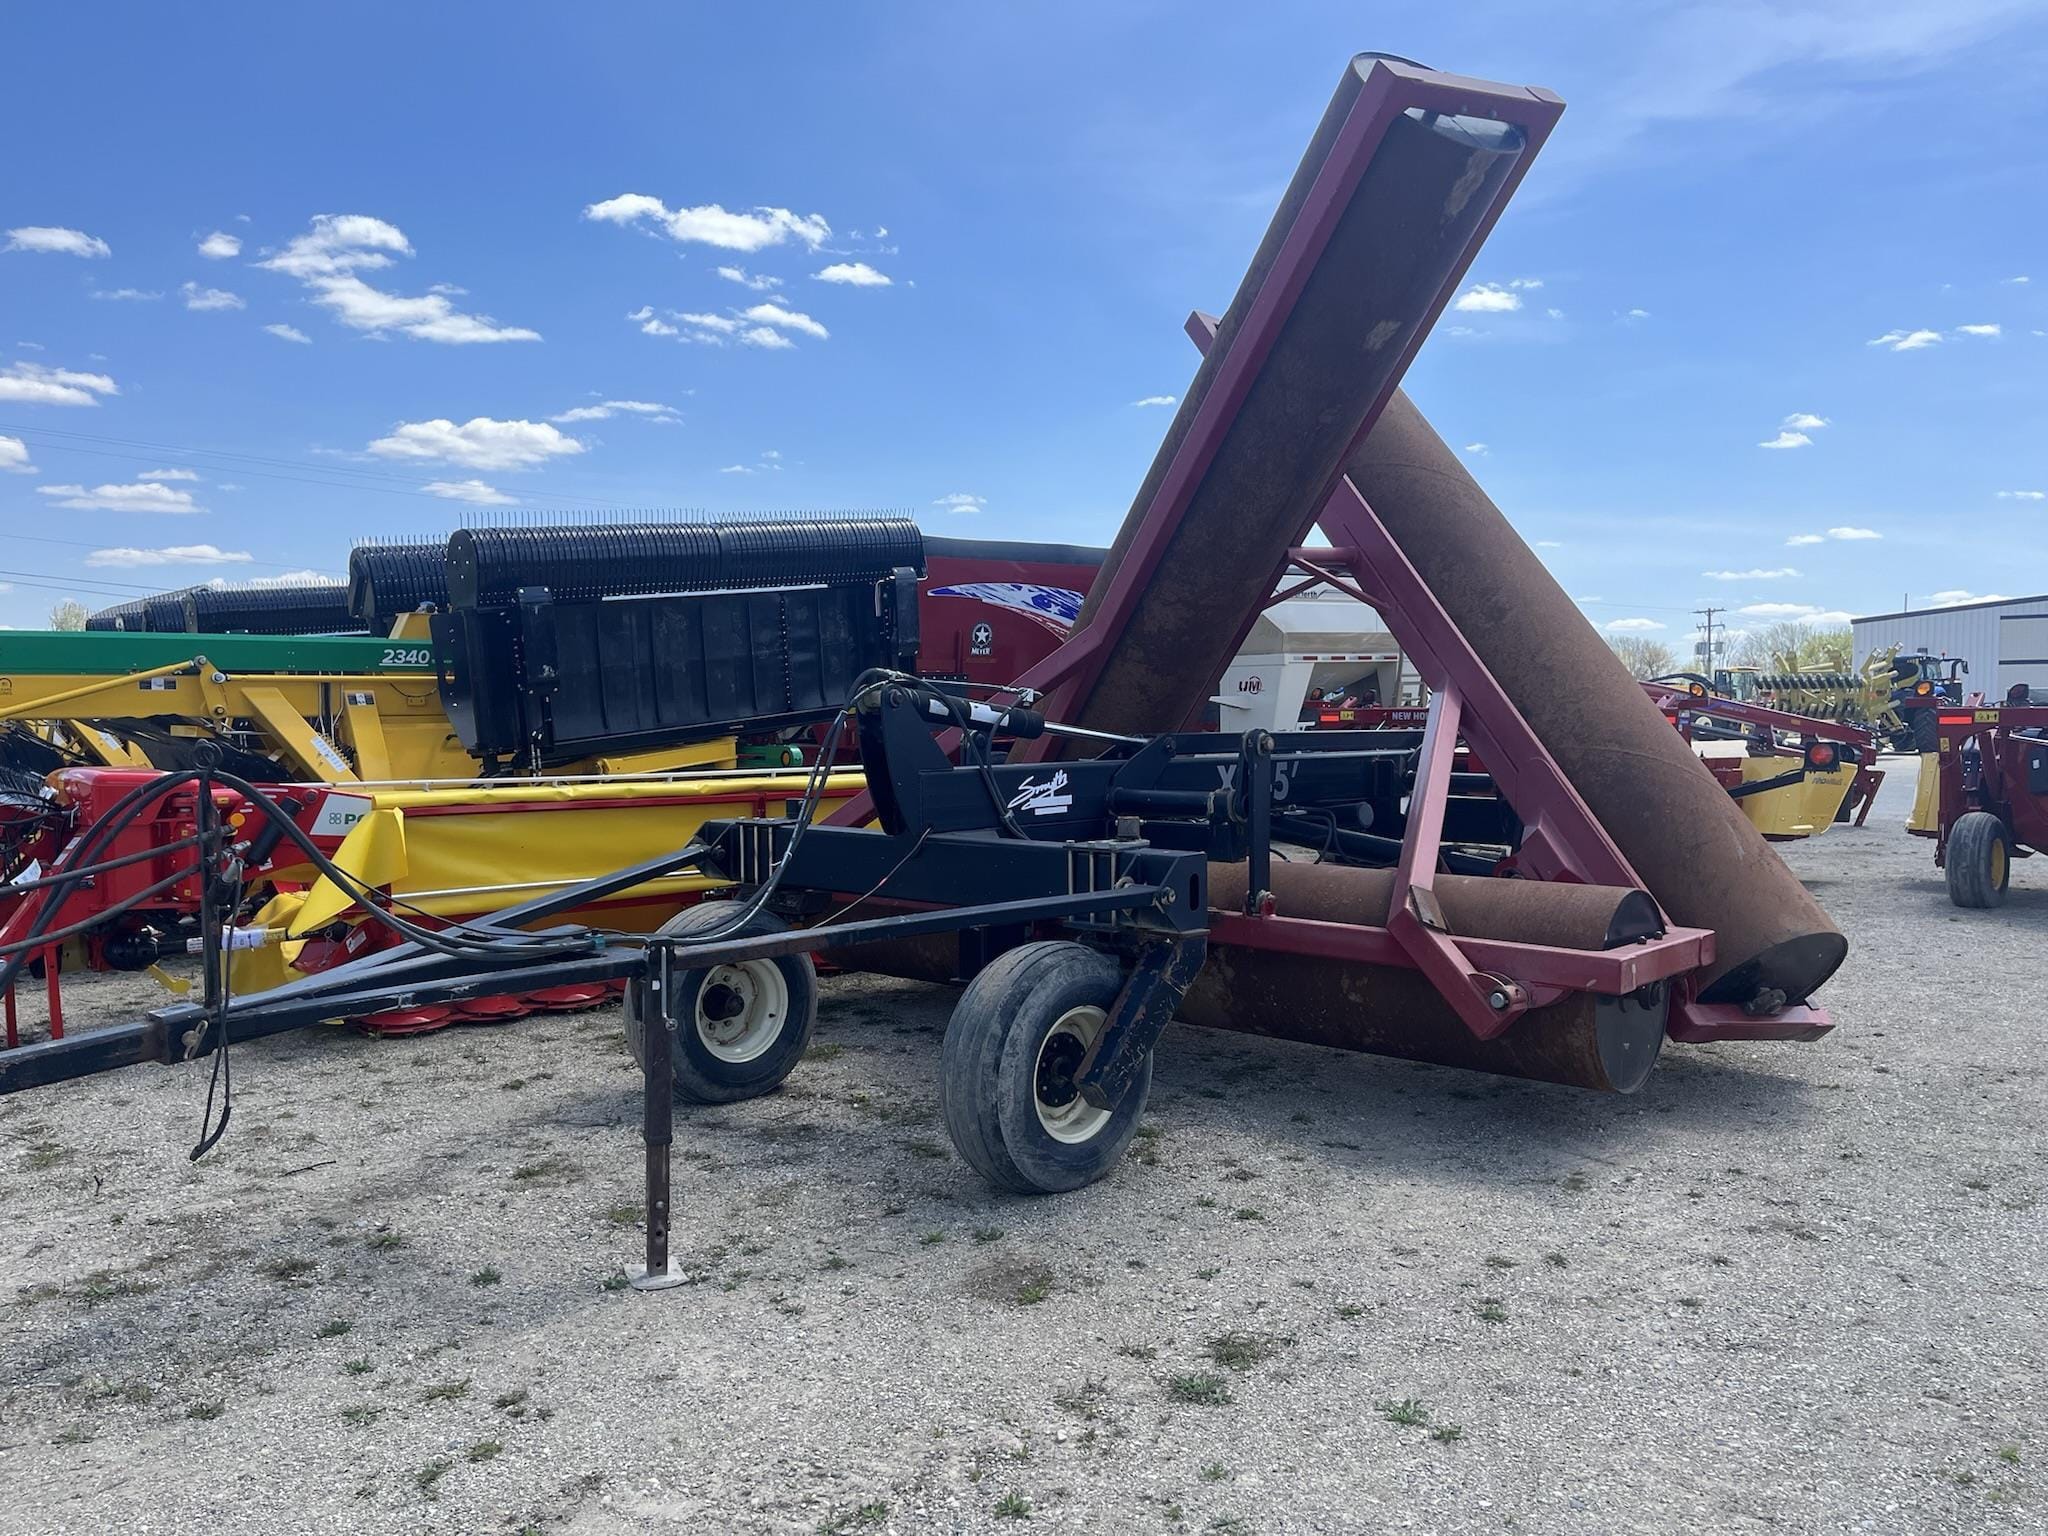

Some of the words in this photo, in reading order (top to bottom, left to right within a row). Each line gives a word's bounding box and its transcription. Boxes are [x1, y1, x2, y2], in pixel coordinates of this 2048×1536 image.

[382, 648, 431, 664] 2340
[971, 647, 991, 656] MEYER
[1391, 711, 1412, 720] NEW
[1007, 769, 1068, 810] Smyth
